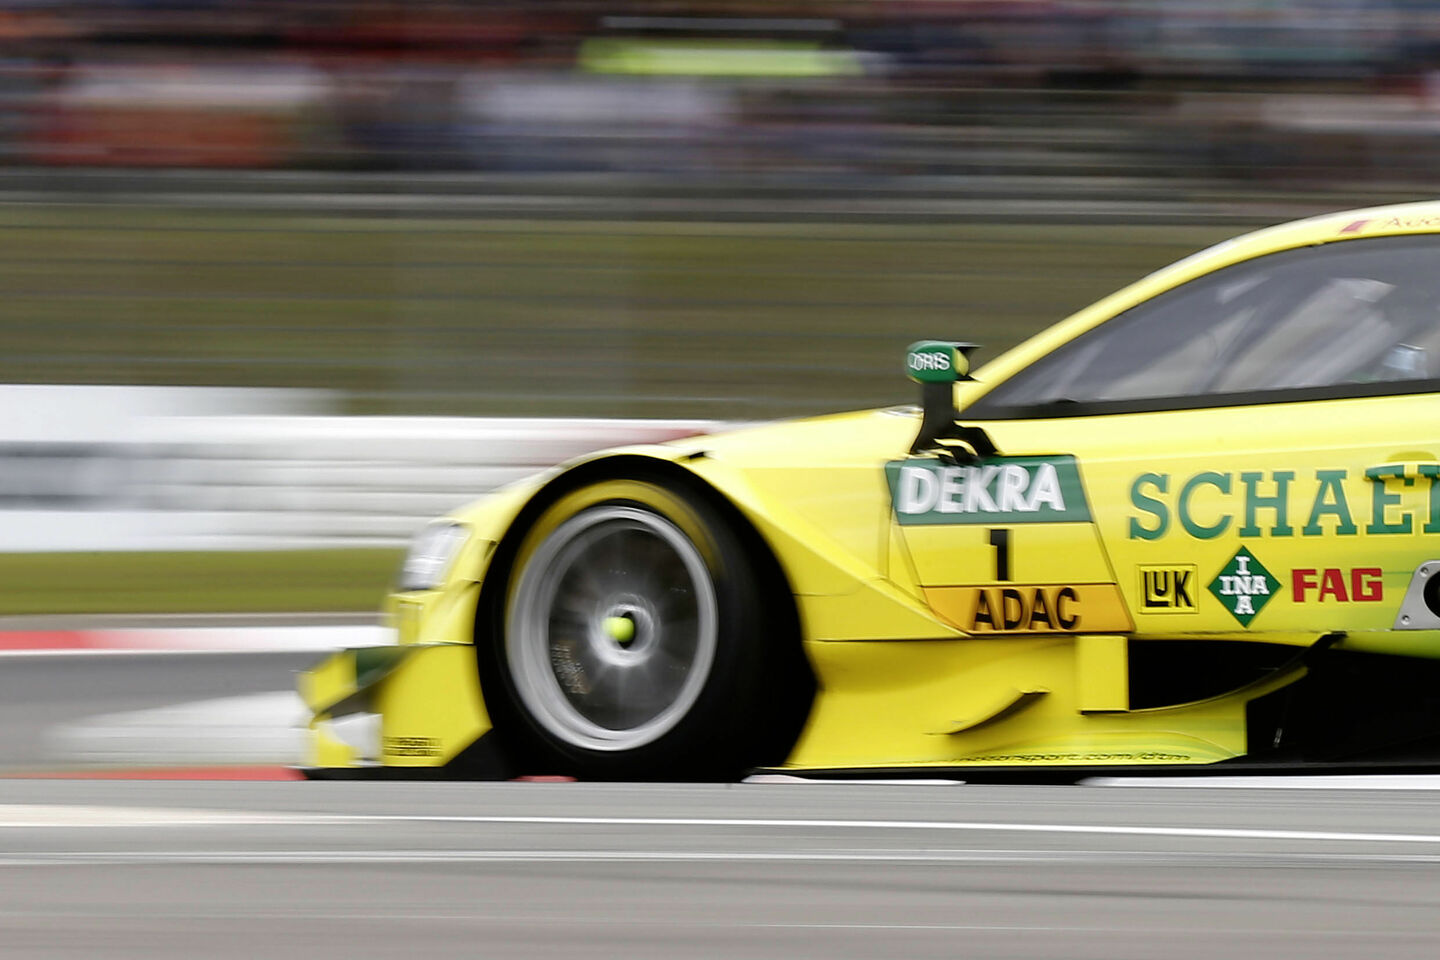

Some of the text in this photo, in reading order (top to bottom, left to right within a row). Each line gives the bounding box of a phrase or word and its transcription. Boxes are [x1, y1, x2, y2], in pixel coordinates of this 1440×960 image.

[897, 462, 1067, 515] DEKRA
[984, 528, 1013, 582] 1
[968, 586, 1081, 631] ADAC
[1291, 567, 1383, 603] FAG
